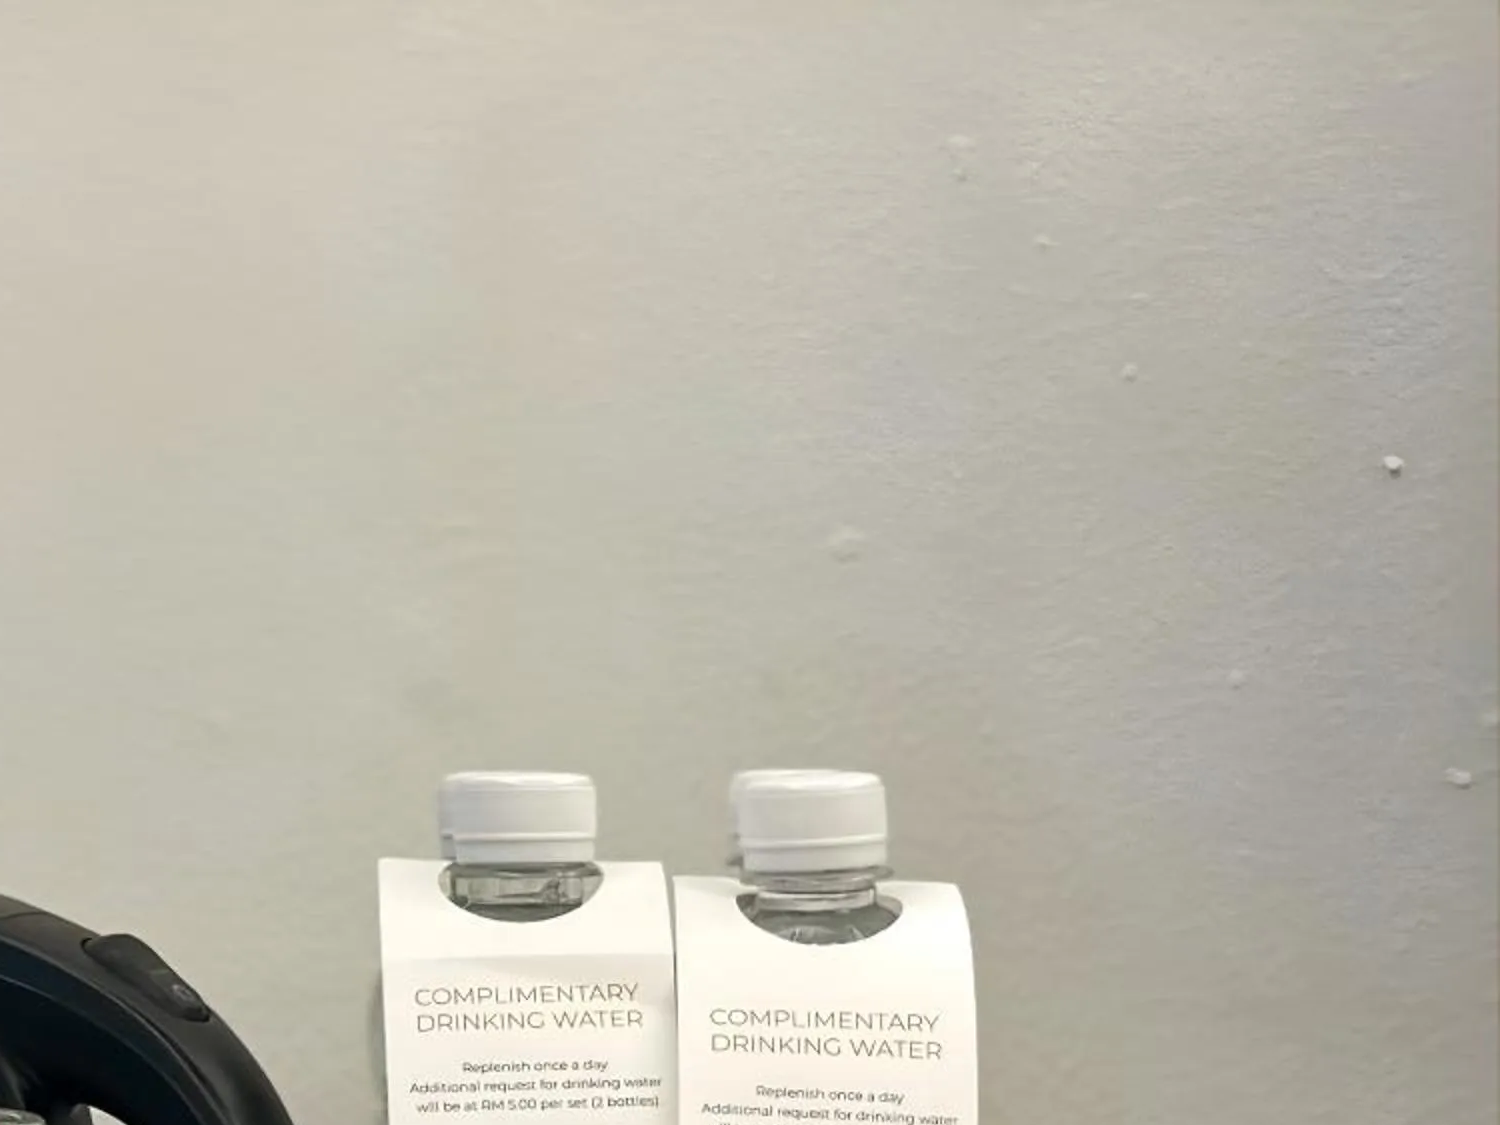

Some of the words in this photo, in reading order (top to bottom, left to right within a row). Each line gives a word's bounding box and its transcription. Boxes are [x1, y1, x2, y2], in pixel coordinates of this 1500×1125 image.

[415, 983, 638, 1006] COMPLIMENTARY
[417, 1012, 545, 1032] DRINKING
[552, 1010, 642, 1028] WATER
[709, 1008, 939, 1032] COMPLIMENTARY
[712, 1034, 841, 1056] DRINKING
[849, 1039, 942, 1060] WATER
[462, 1062, 530, 1074] Replenish
[533, 1061, 568, 1072] once
[571, 1061, 580, 1071] a
[583, 1060, 608, 1072] day
[410, 1080, 480, 1094] Additional
[484, 1081, 536, 1094] request
[540, 1079, 558, 1090] for
[561, 1078, 621, 1091] drinking
[624, 1078, 662, 1088] water
[756, 1085, 825, 1099] Replenish
[828, 1091, 863, 1102] once
[867, 1093, 875, 1102] a
[878, 1092, 905, 1106] day
[416, 1101, 439, 1113] will
[443, 1101, 461, 1112] be
[463, 1101, 479, 1113] at
[481, 1099, 505, 1111] RM
[508, 1097, 537, 1111] 5.00
[541, 1100, 563, 1111] per
[567, 1098, 588, 1109] set
[591, 1096, 604, 1110] (2
[701, 1104, 773, 1117] Additional
[777, 1108, 830, 1120] request
[834, 1109, 852, 1120] for
[855, 1111, 915, 1125] drinking
[919, 1116, 957, 1125] water
